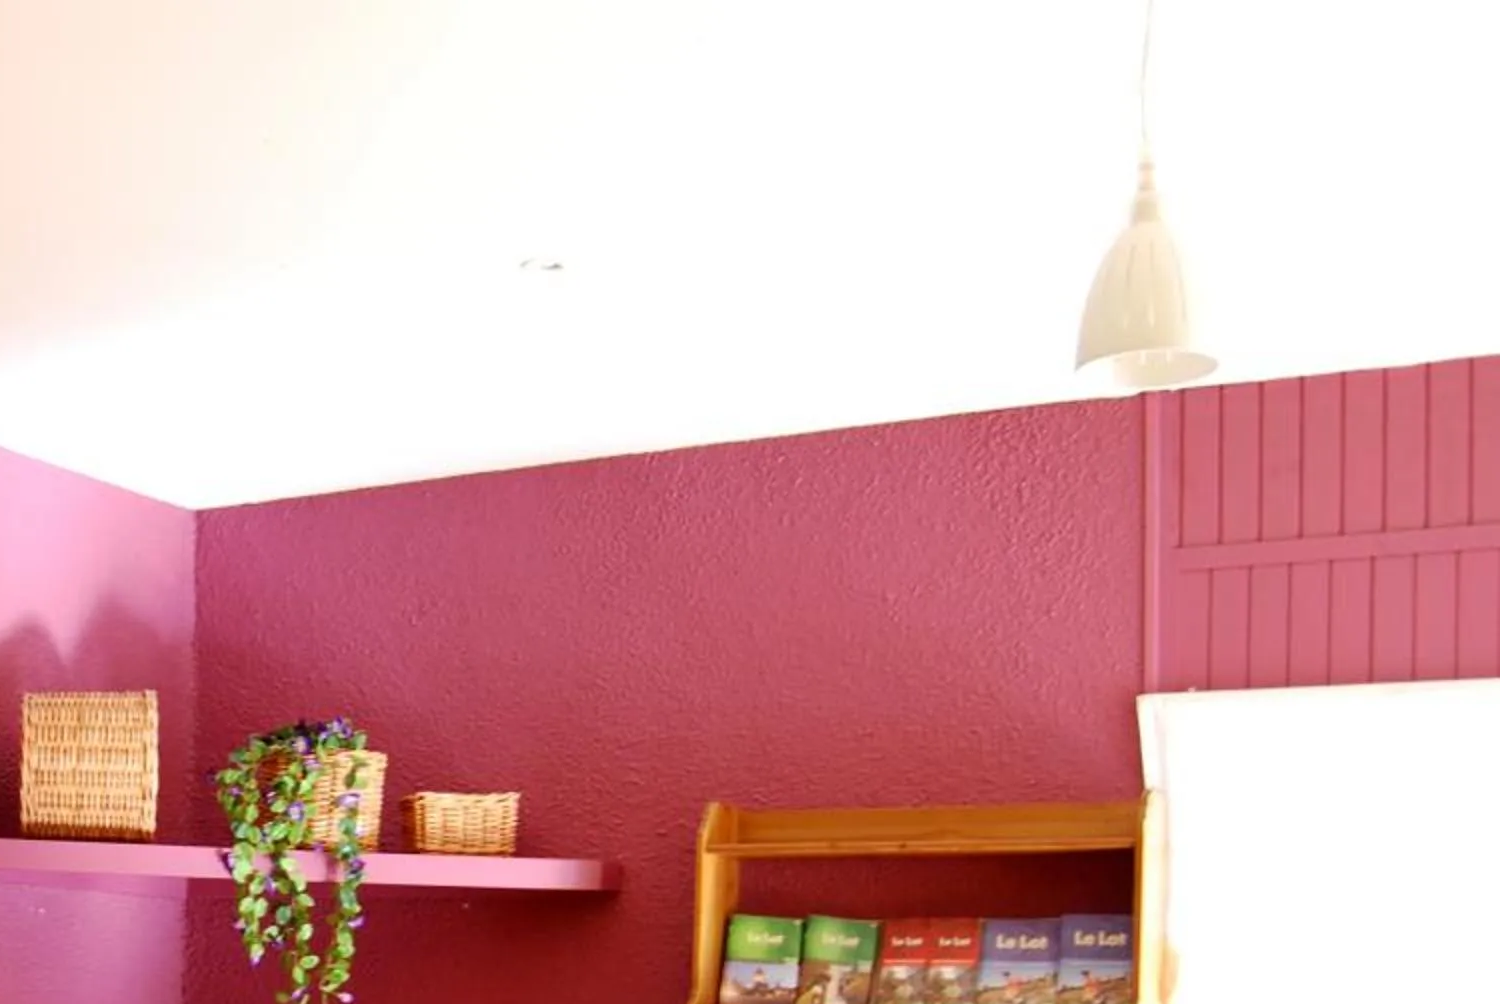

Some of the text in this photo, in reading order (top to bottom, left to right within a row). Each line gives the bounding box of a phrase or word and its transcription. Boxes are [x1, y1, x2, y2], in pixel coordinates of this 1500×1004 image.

[996, 933, 1049, 950] Le Lot
[1074, 930, 1127, 946] Le Lot
